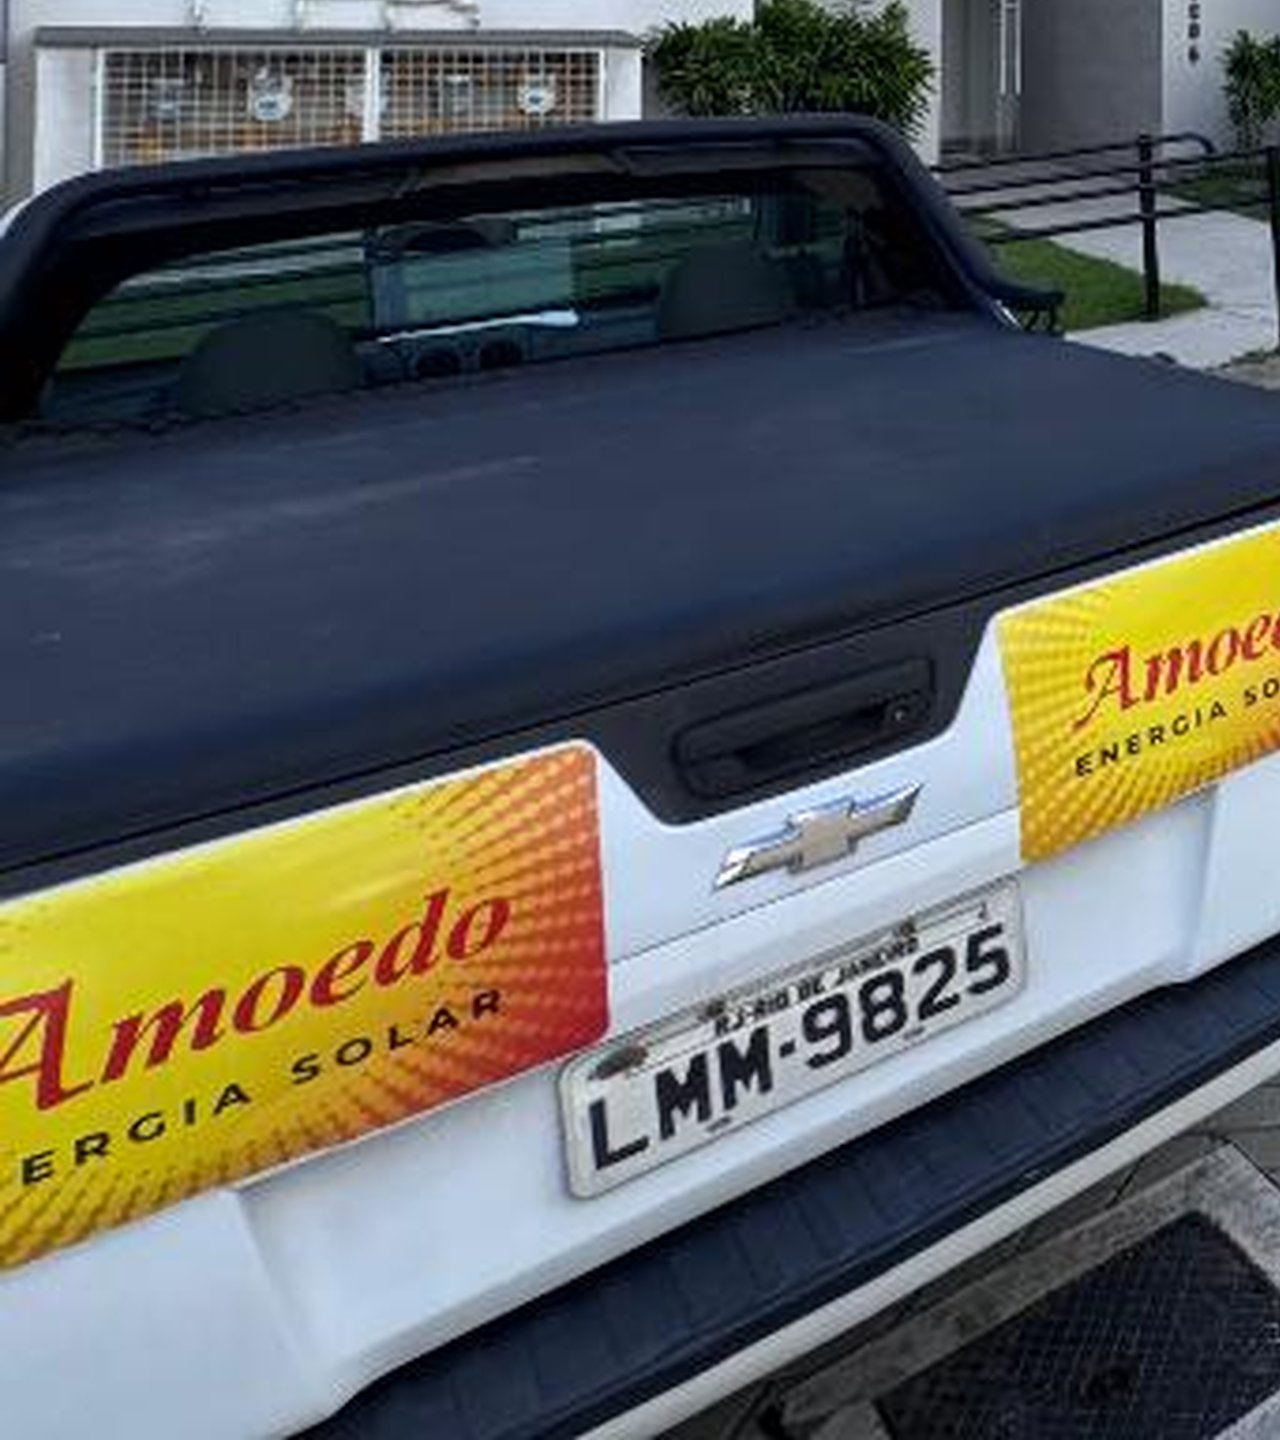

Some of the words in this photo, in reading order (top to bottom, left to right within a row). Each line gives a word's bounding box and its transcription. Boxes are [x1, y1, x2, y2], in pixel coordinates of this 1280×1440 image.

[1074, 698, 1227, 777] ENERGIA
[0, 887, 511, 1112] Amoedo
[290, 987, 503, 1086] SOLAR
[588, 923, 1010, 1171] LMM-9825
